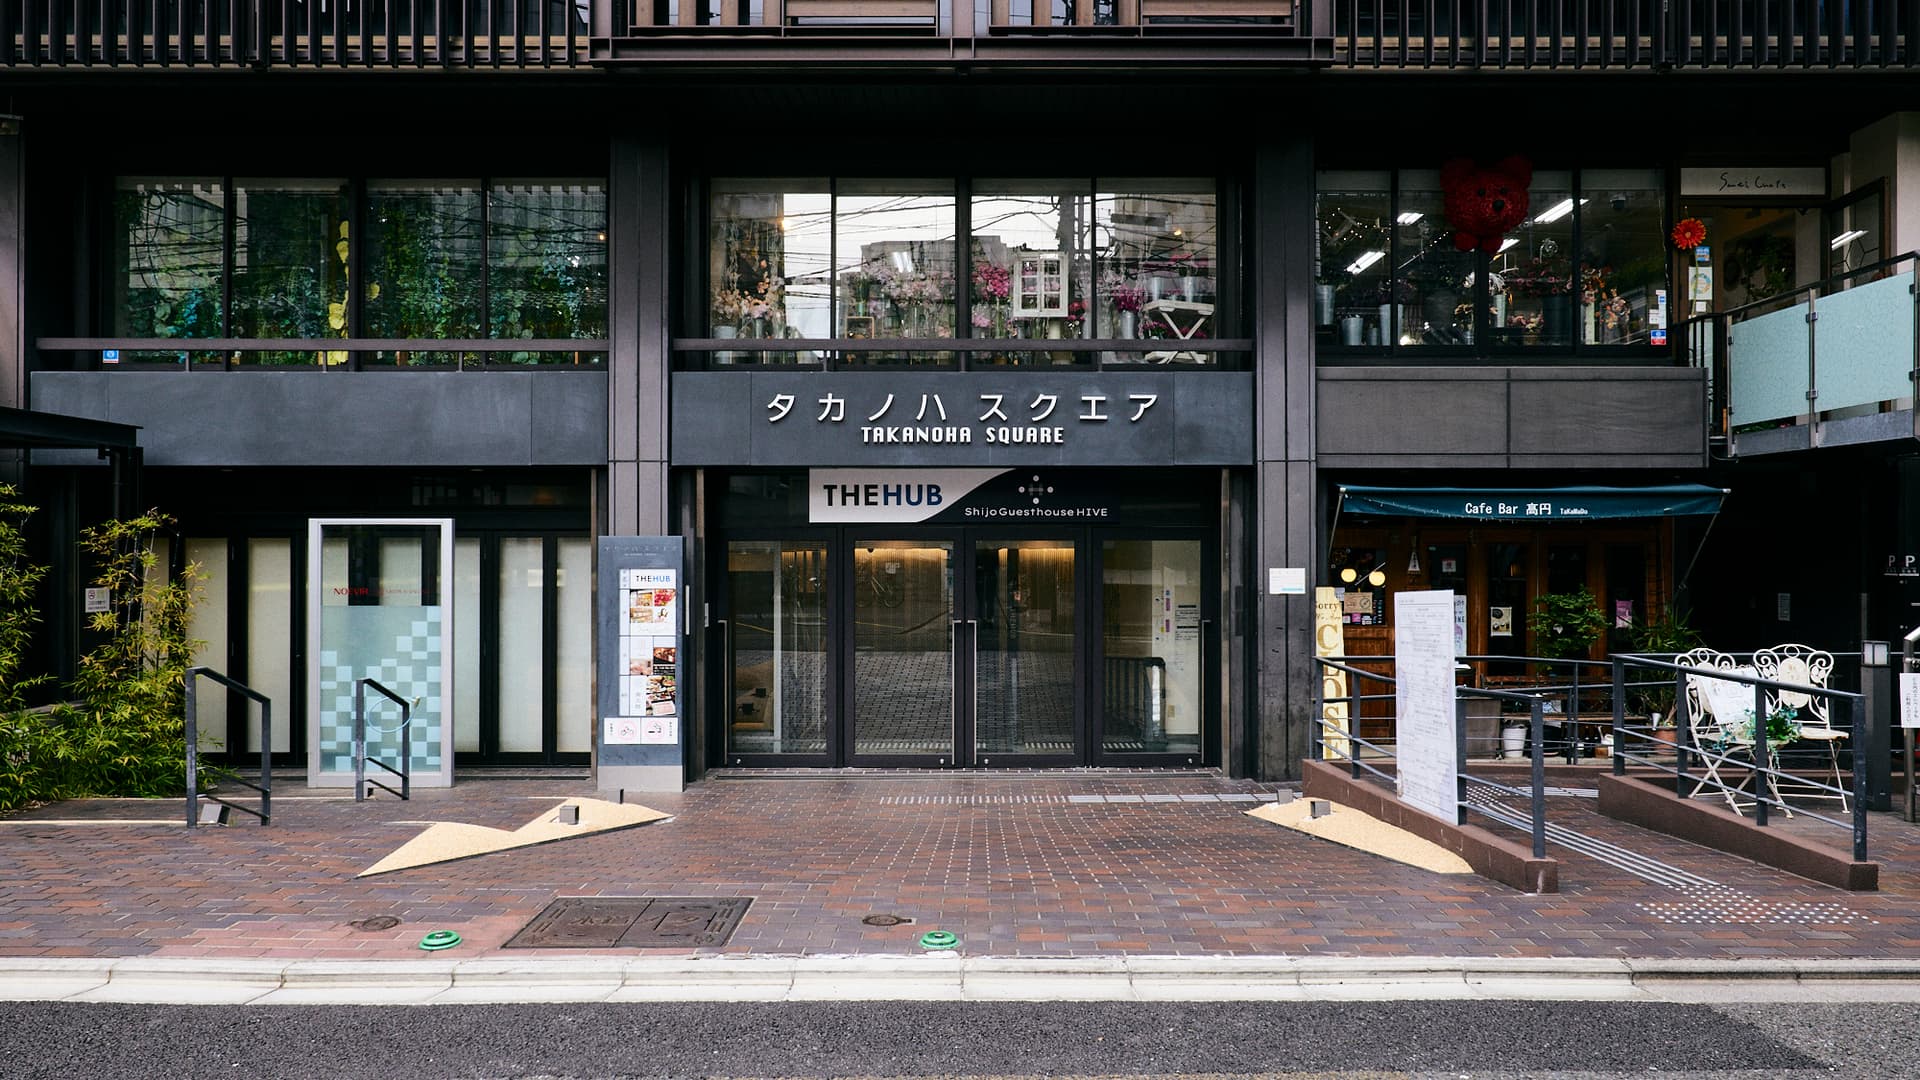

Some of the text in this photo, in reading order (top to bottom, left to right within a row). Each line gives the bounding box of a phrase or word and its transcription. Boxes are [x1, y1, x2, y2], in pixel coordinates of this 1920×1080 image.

[860, 426, 1064, 444] TAKANOHA SQUARE
[1465, 502, 1493, 515] Cafe
[1498, 502, 1519, 515] Bar
[1905, 554, 1916, 568] P
[1315, 603, 1340, 613] orry
